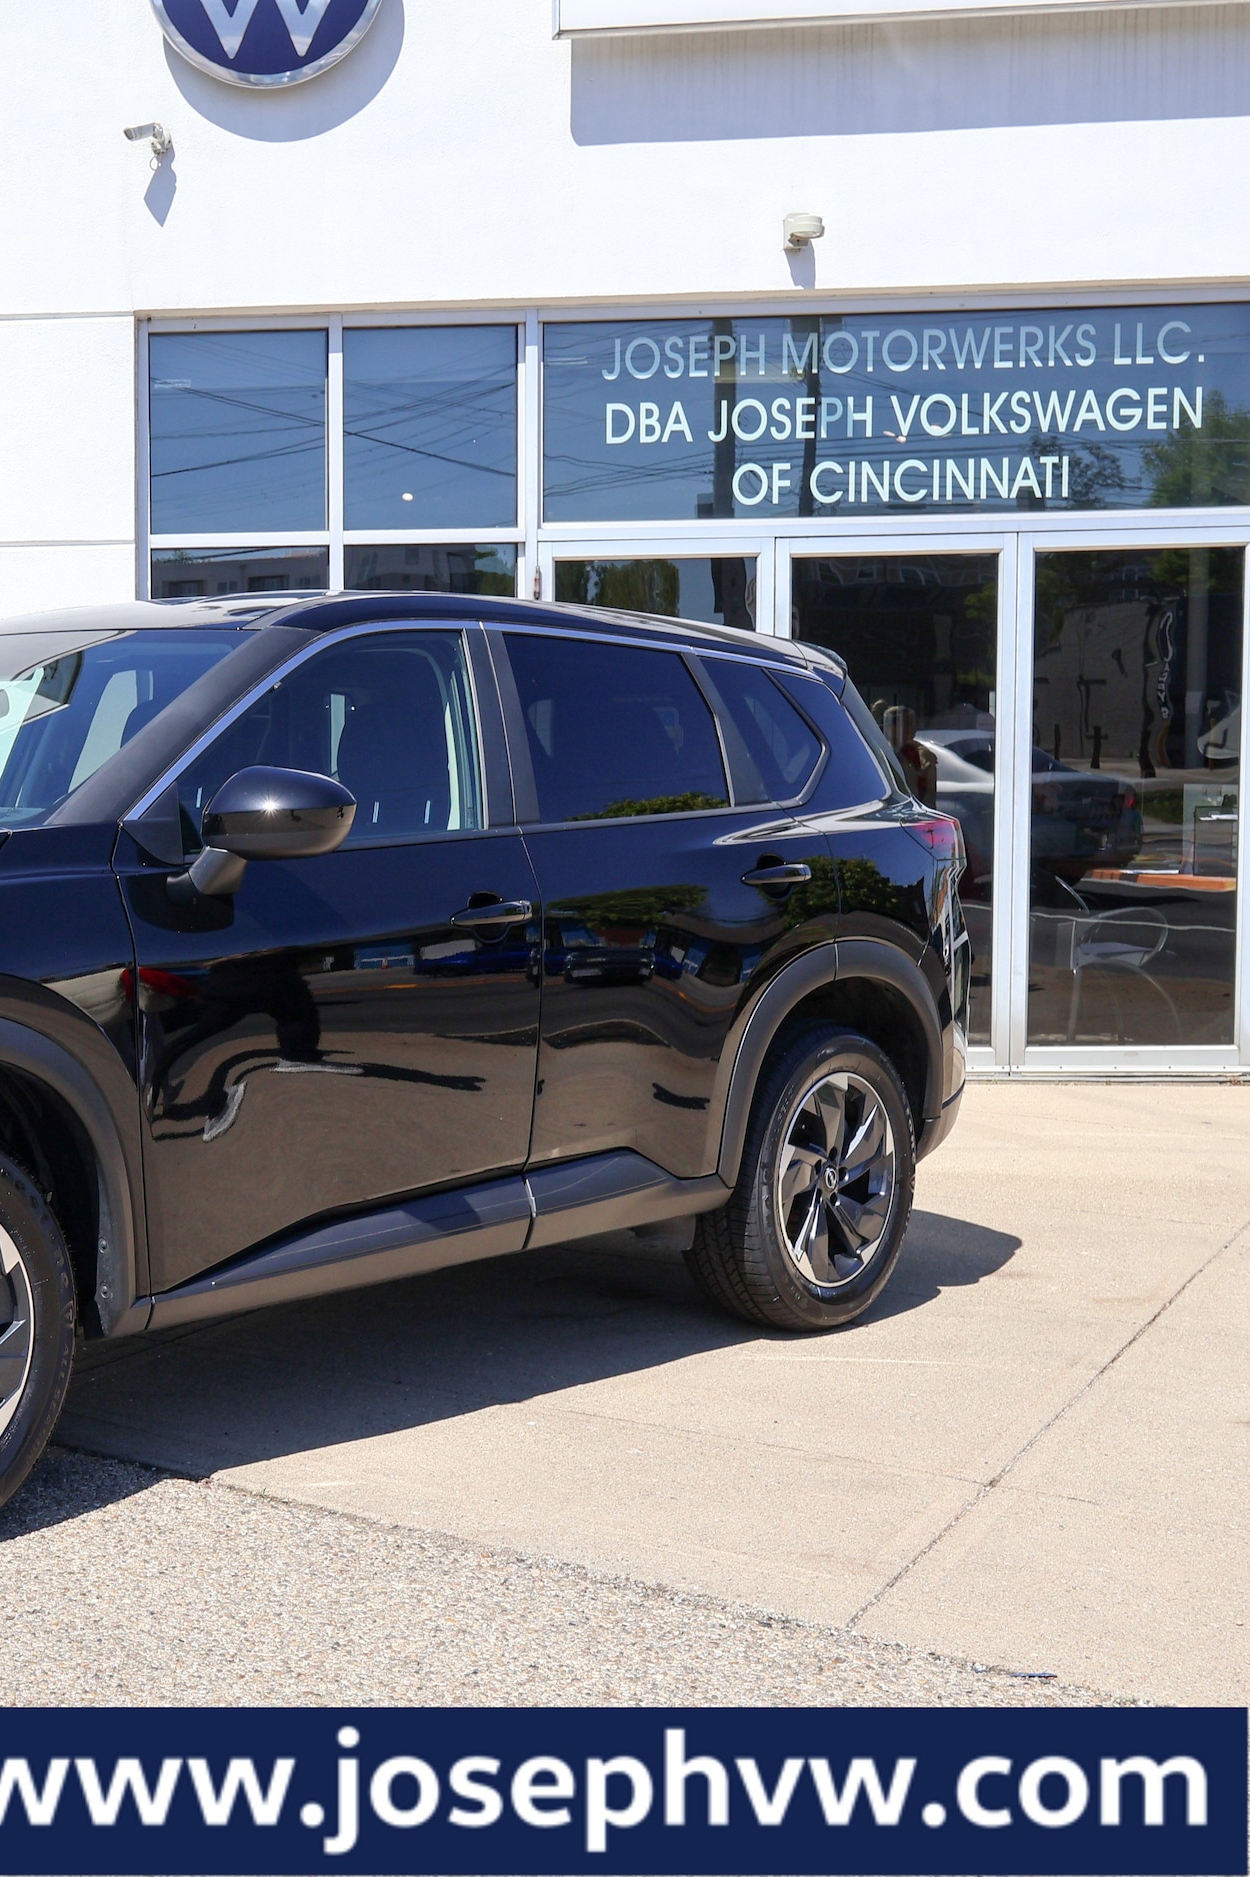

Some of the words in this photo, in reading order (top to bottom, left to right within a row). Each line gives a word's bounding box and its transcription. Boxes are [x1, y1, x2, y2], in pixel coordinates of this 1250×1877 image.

[602, 333, 766, 380] JOSEPH
[782, 322, 1097, 375] MOTORWERKS
[1113, 320, 1205, 366] LLC.
[605, 401, 694, 445] DBA
[707, 395, 873, 442] JOSEPH
[890, 386, 1203, 438] VOLKSWAGEN
[731, 461, 791, 505] OF
[809, 455, 1069, 503] CINCINNATI
